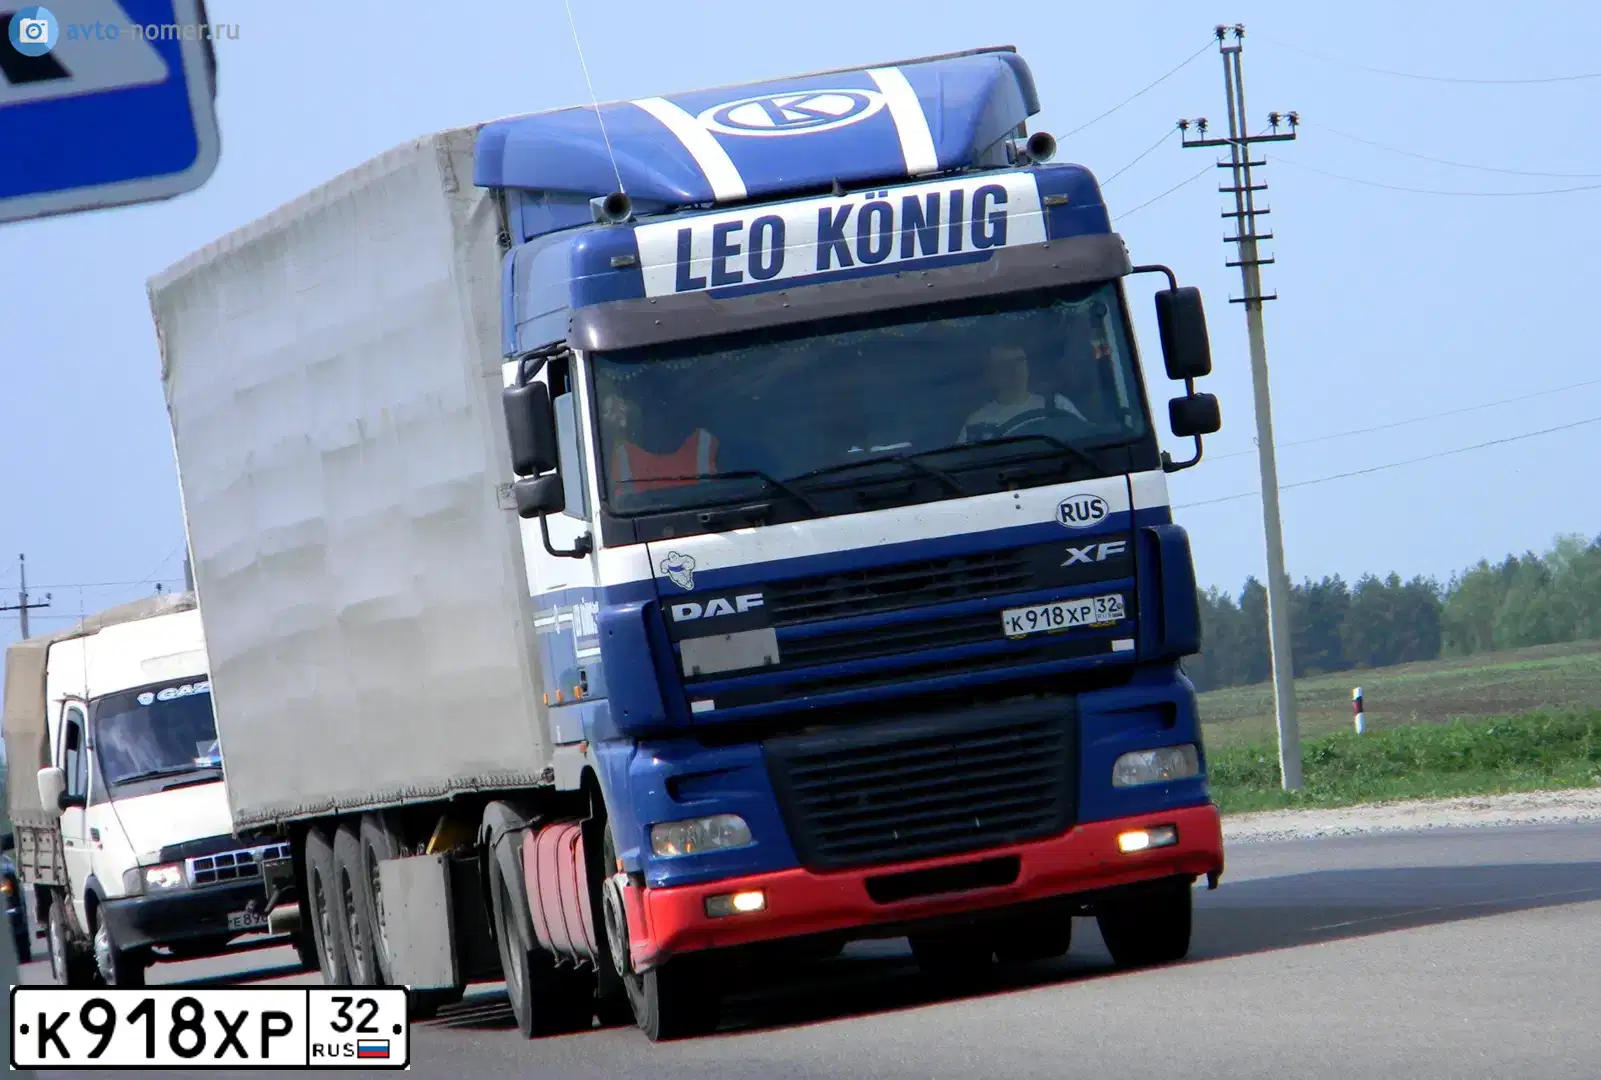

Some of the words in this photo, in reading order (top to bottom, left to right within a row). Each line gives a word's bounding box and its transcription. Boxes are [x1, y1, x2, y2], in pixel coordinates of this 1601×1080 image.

[675, 215, 786, 293] LEO
[817, 184, 1009, 272] KÖNIG
[1060, 499, 1104, 523] RUS
[1060, 540, 1127, 567] XF
[671, 593, 764, 622] DAF
[1097, 597, 1117, 613] 32
